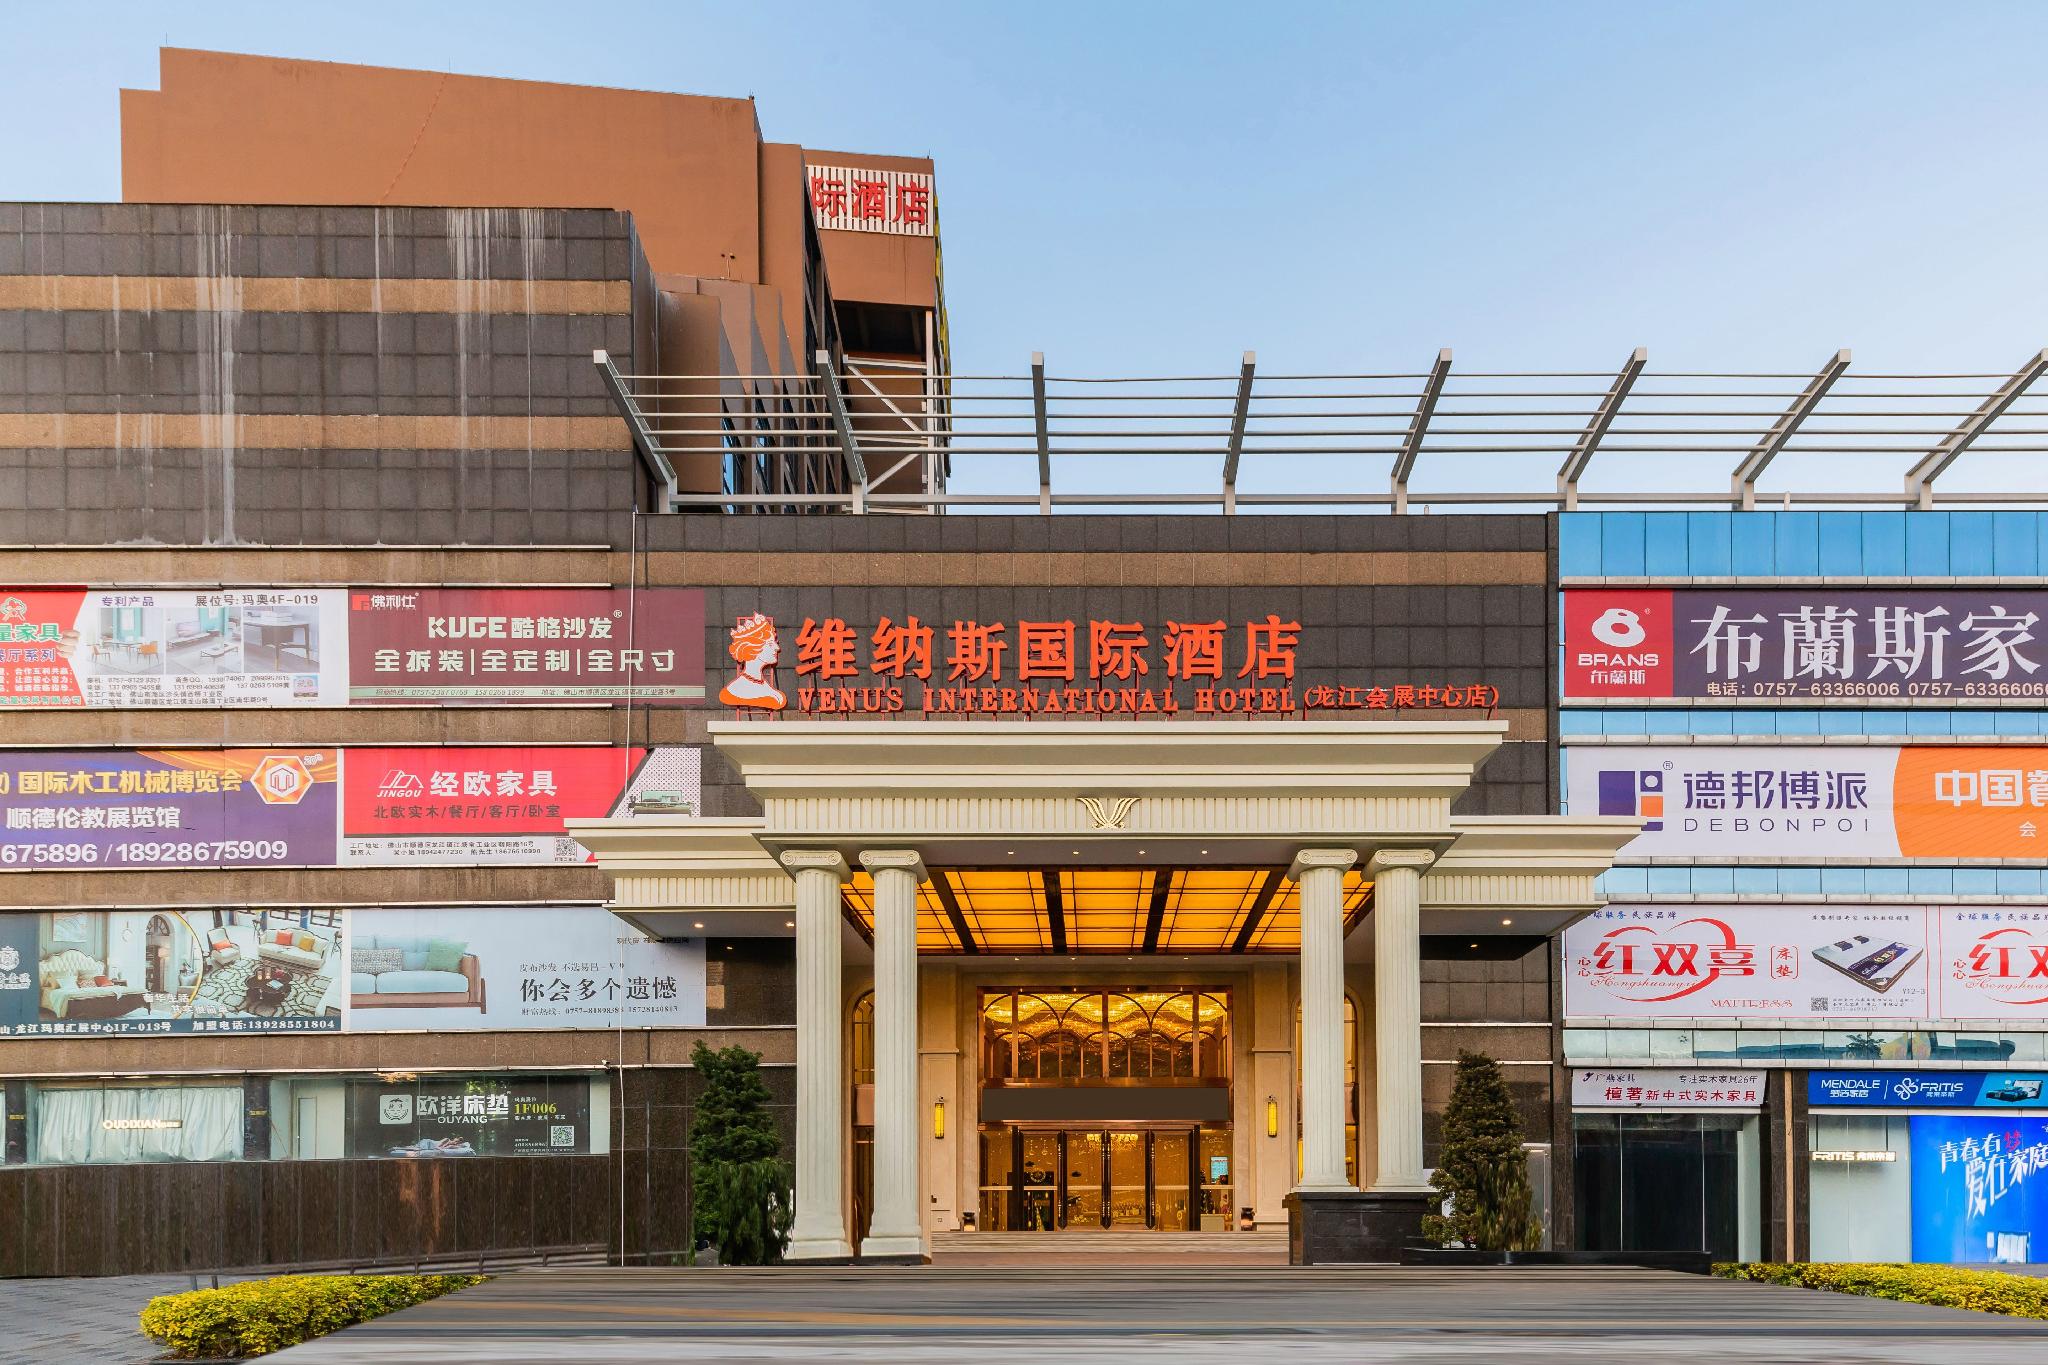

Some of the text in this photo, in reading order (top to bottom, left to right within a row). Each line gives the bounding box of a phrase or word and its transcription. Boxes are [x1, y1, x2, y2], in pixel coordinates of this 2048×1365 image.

[811, 175, 929, 225] 际酒店
[102, 595, 154, 607] 专利产品
[371, 595, 416, 608] 佛利仕
[428, 617, 613, 639] KUGE 酷格沙发
[795, 614, 1302, 682] 维纳斯国际酒店
[1690, 605, 2041, 680] 布蘭斯家
[1578, 654, 1659, 666] BRANS
[799, 687, 1296, 712] VENUS INTERNATIONAL HOTEL
[1304, 684, 1499, 709] (龙江会展中心店)
[1753, 683, 1900, 696] 0757-63366006
[18, 769, 243, 794] 国际木工机械博览会
[429, 770, 557, 797] 经欧家具
[1684, 771, 1868, 810] 德邦博派
[376, 789, 421, 798] JINGOU
[6, 807, 181, 829] 顺德伦教展览馆
[1, 844, 97, 863] 675896
[114, 840, 288, 863] 18928675909
[1594, 942, 1757, 977] 红双喜
[520, 976, 677, 1002] 你会多个遗憾
[1821, 1079, 1880, 1088] MENDALE
[1919, 1083, 1963, 1091] FRITIS
[416, 1095, 508, 1115] 欧洋床垫
[514, 1103, 556, 1114] 1F006
